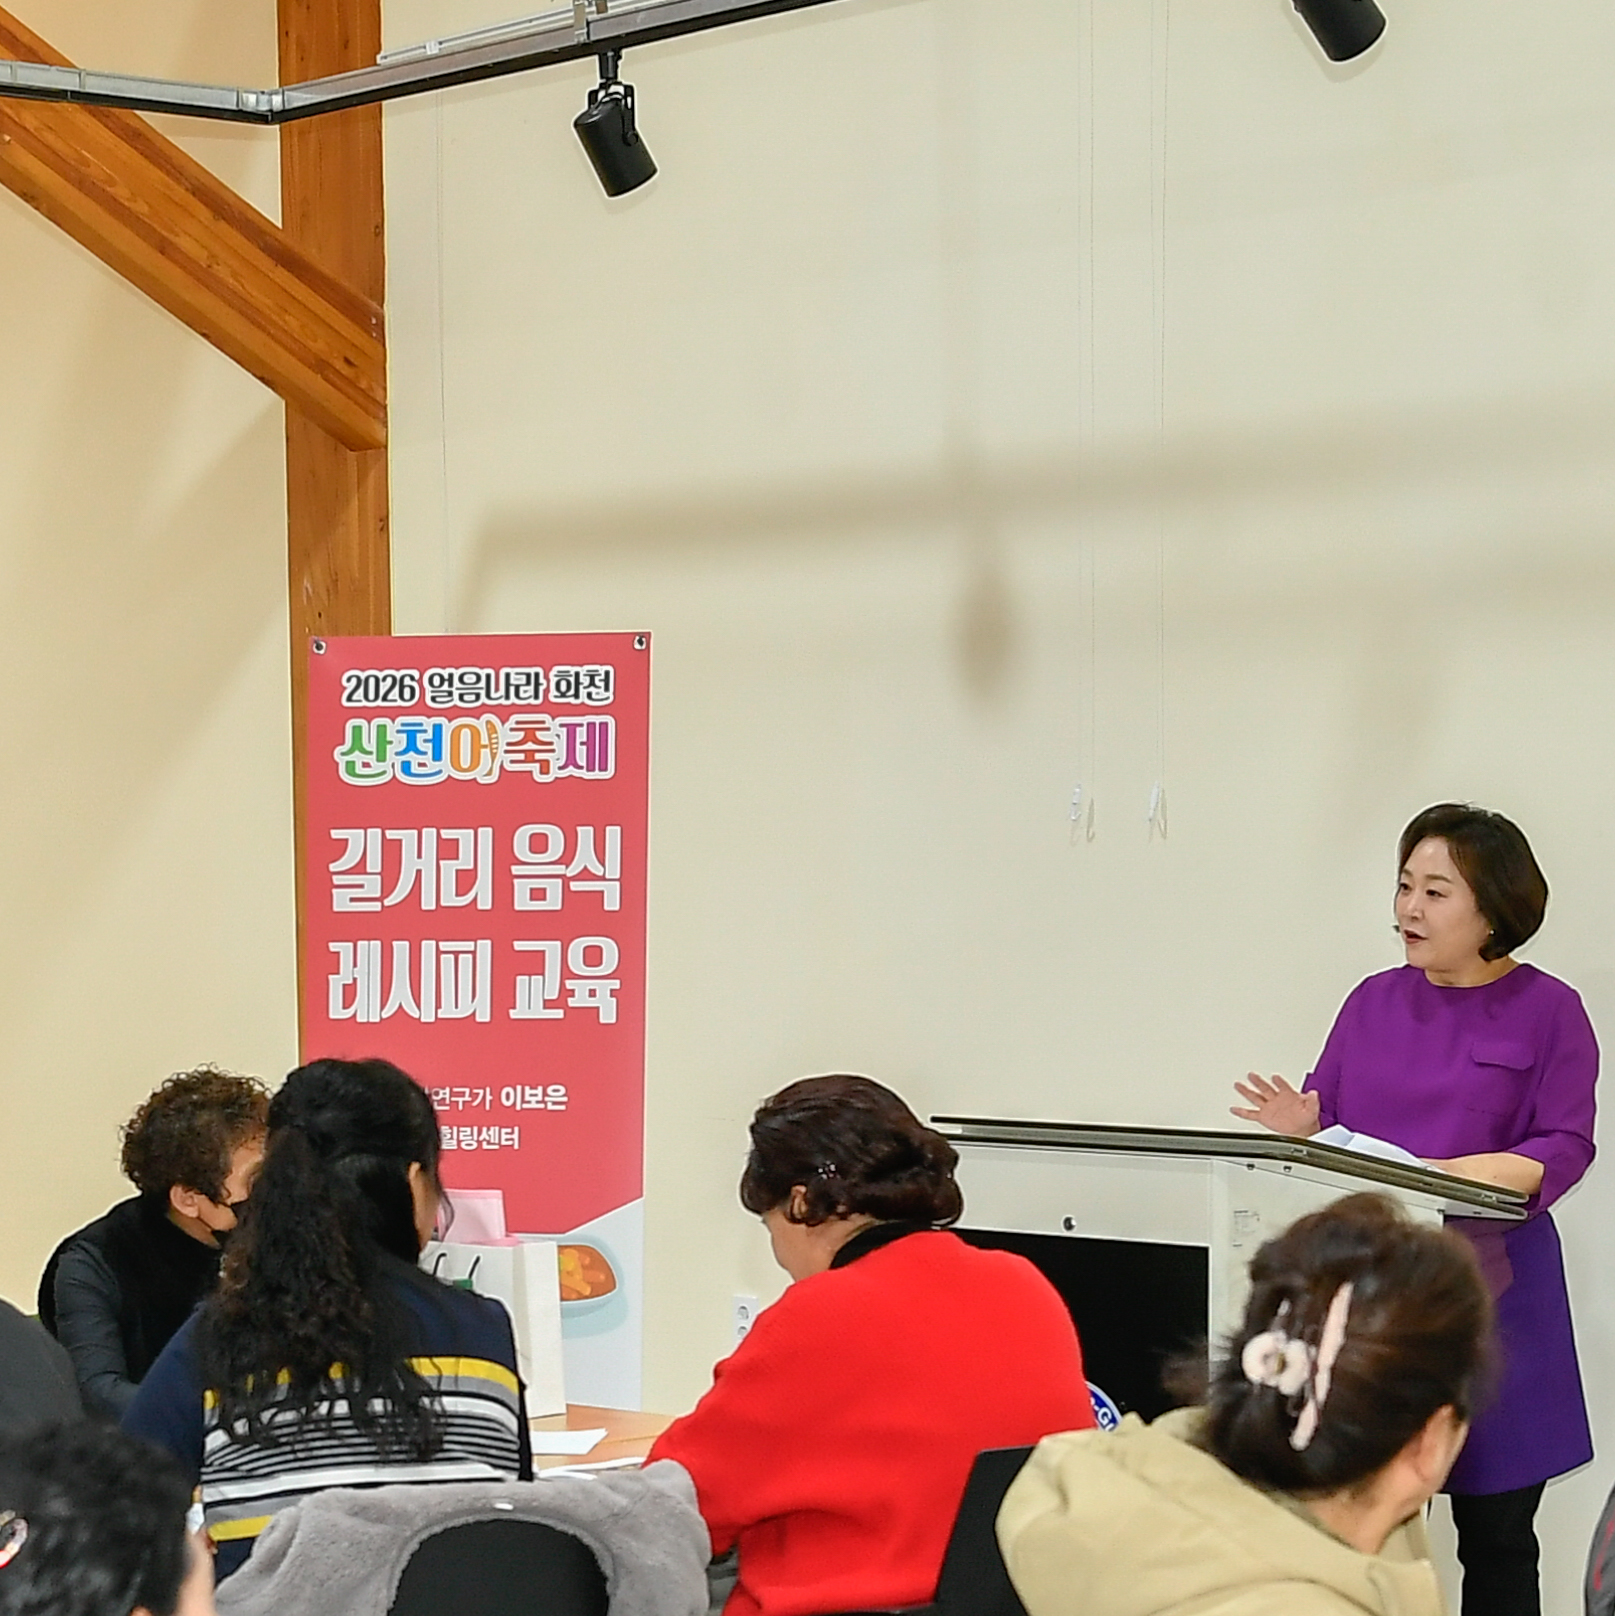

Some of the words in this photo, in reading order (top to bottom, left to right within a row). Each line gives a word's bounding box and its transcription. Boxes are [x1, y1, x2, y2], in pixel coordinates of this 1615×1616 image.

[343, 672, 418, 704] 2026
[427, 669, 544, 704] 얼음나라
[552, 668, 612, 703] 화천
[340, 718, 610, 779] 산천어축제
[328, 827, 493, 912] 길거리
[511, 824, 621, 911] 음식
[328, 939, 491, 1023] 레시피
[509, 936, 621, 1024] 교육
[425, 1086, 493, 1111] 연구가
[500, 1084, 569, 1111] 이보은
